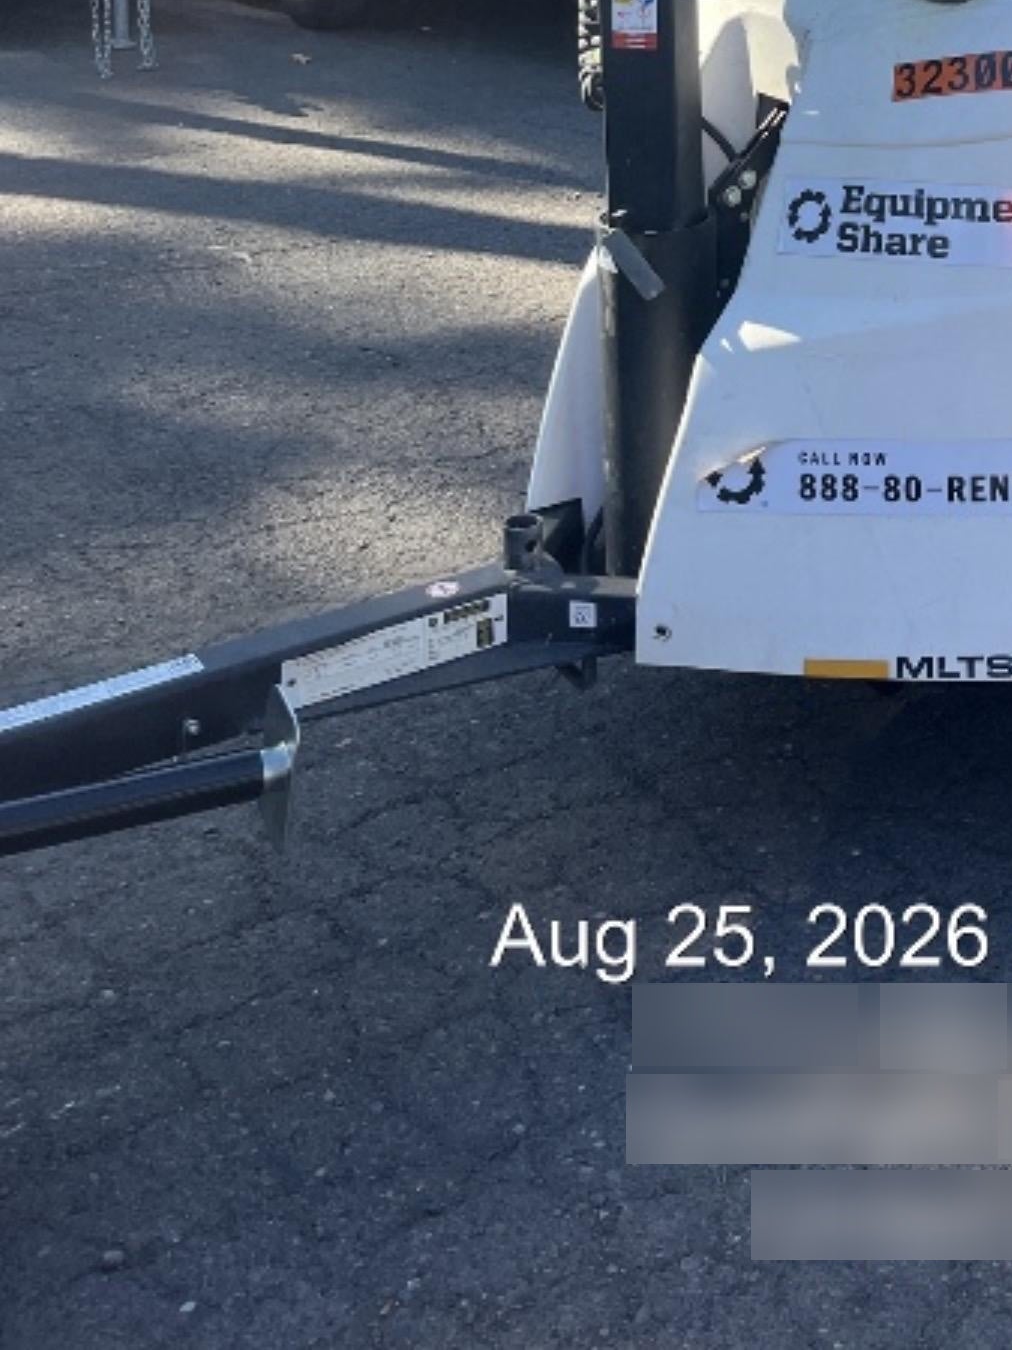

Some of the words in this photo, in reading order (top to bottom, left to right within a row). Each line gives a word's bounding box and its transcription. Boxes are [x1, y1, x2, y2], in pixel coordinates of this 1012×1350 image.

[836, 221, 949, 259] Share
[798, 452, 841, 466] CALL
[848, 452, 887, 466] NOW
